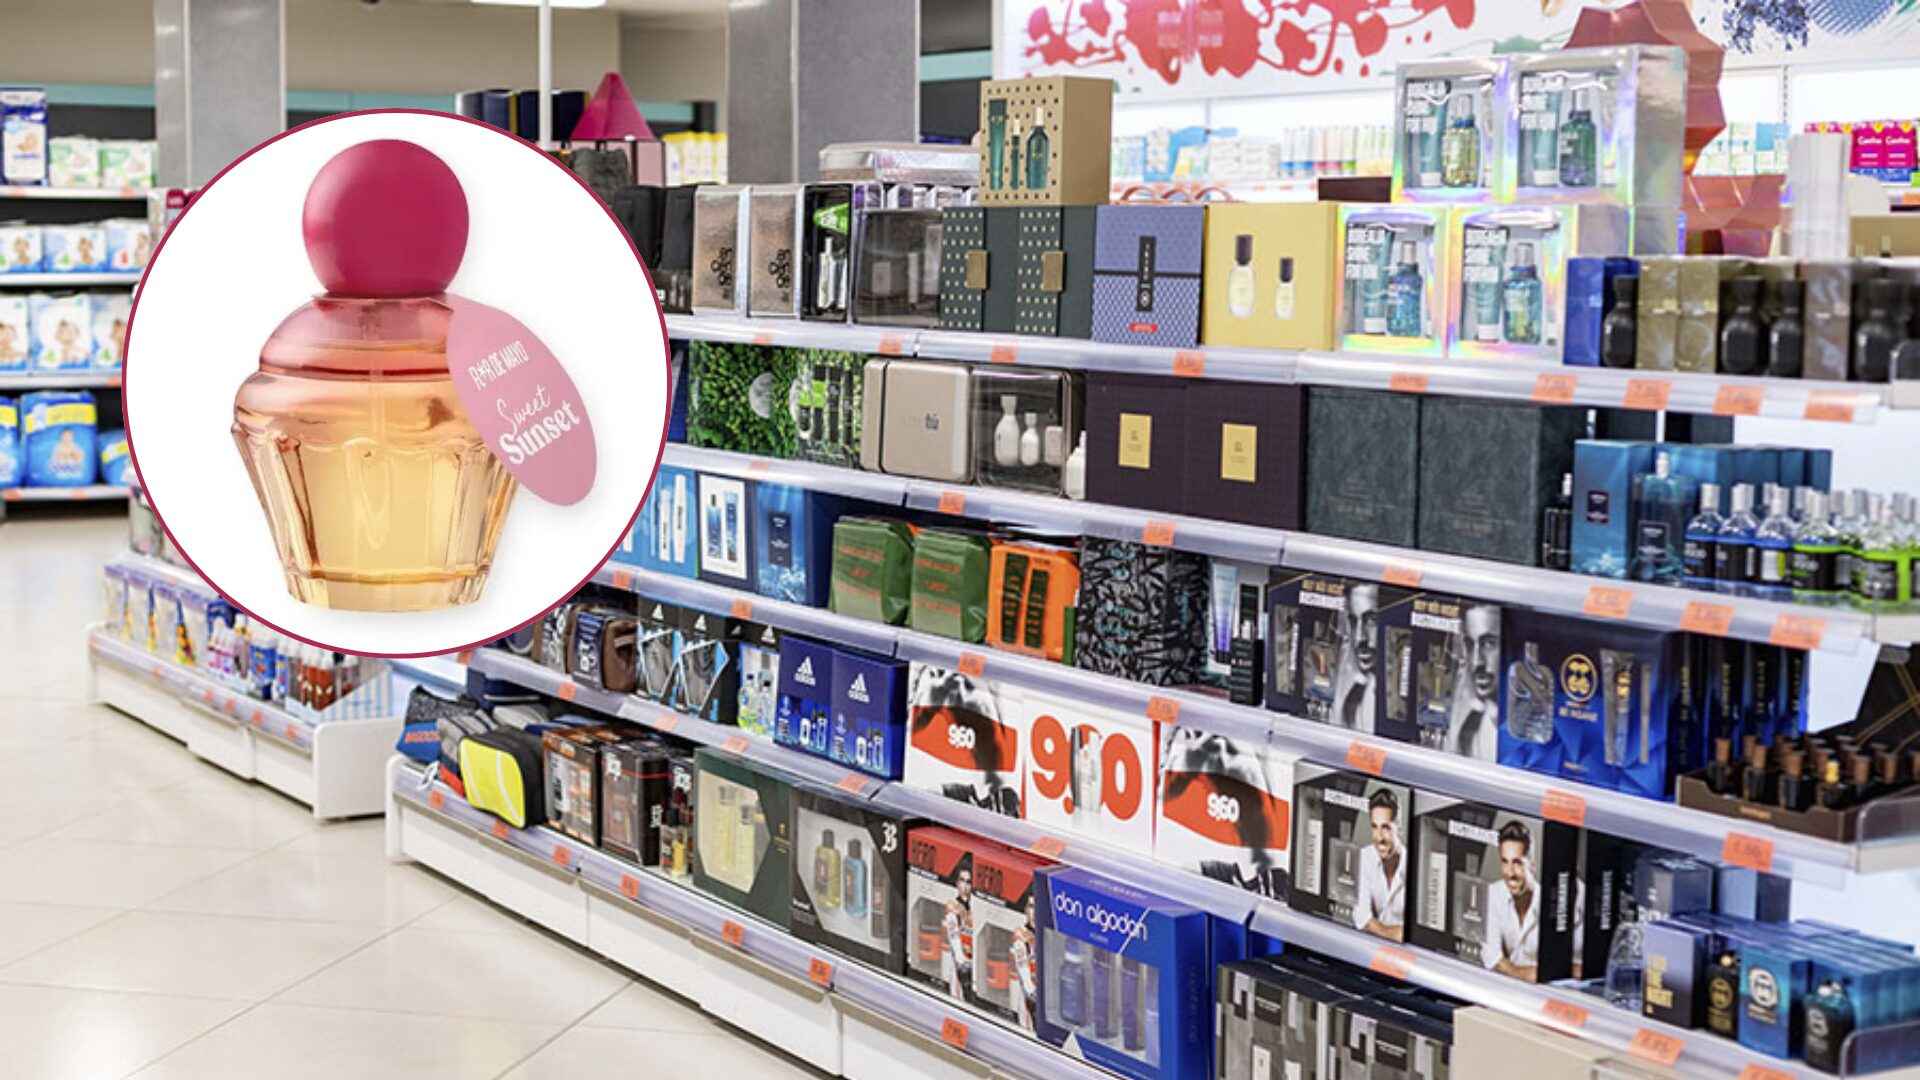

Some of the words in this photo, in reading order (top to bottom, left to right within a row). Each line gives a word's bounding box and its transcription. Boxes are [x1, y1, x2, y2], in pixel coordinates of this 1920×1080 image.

[488, 352, 507, 377] DE
[498, 340, 529, 370] MAYO
[496, 384, 550, 434] Sweet
[499, 399, 580, 464] Sunset
[1054, 891, 1083, 918] don
[1086, 903, 1148, 941] algodon
